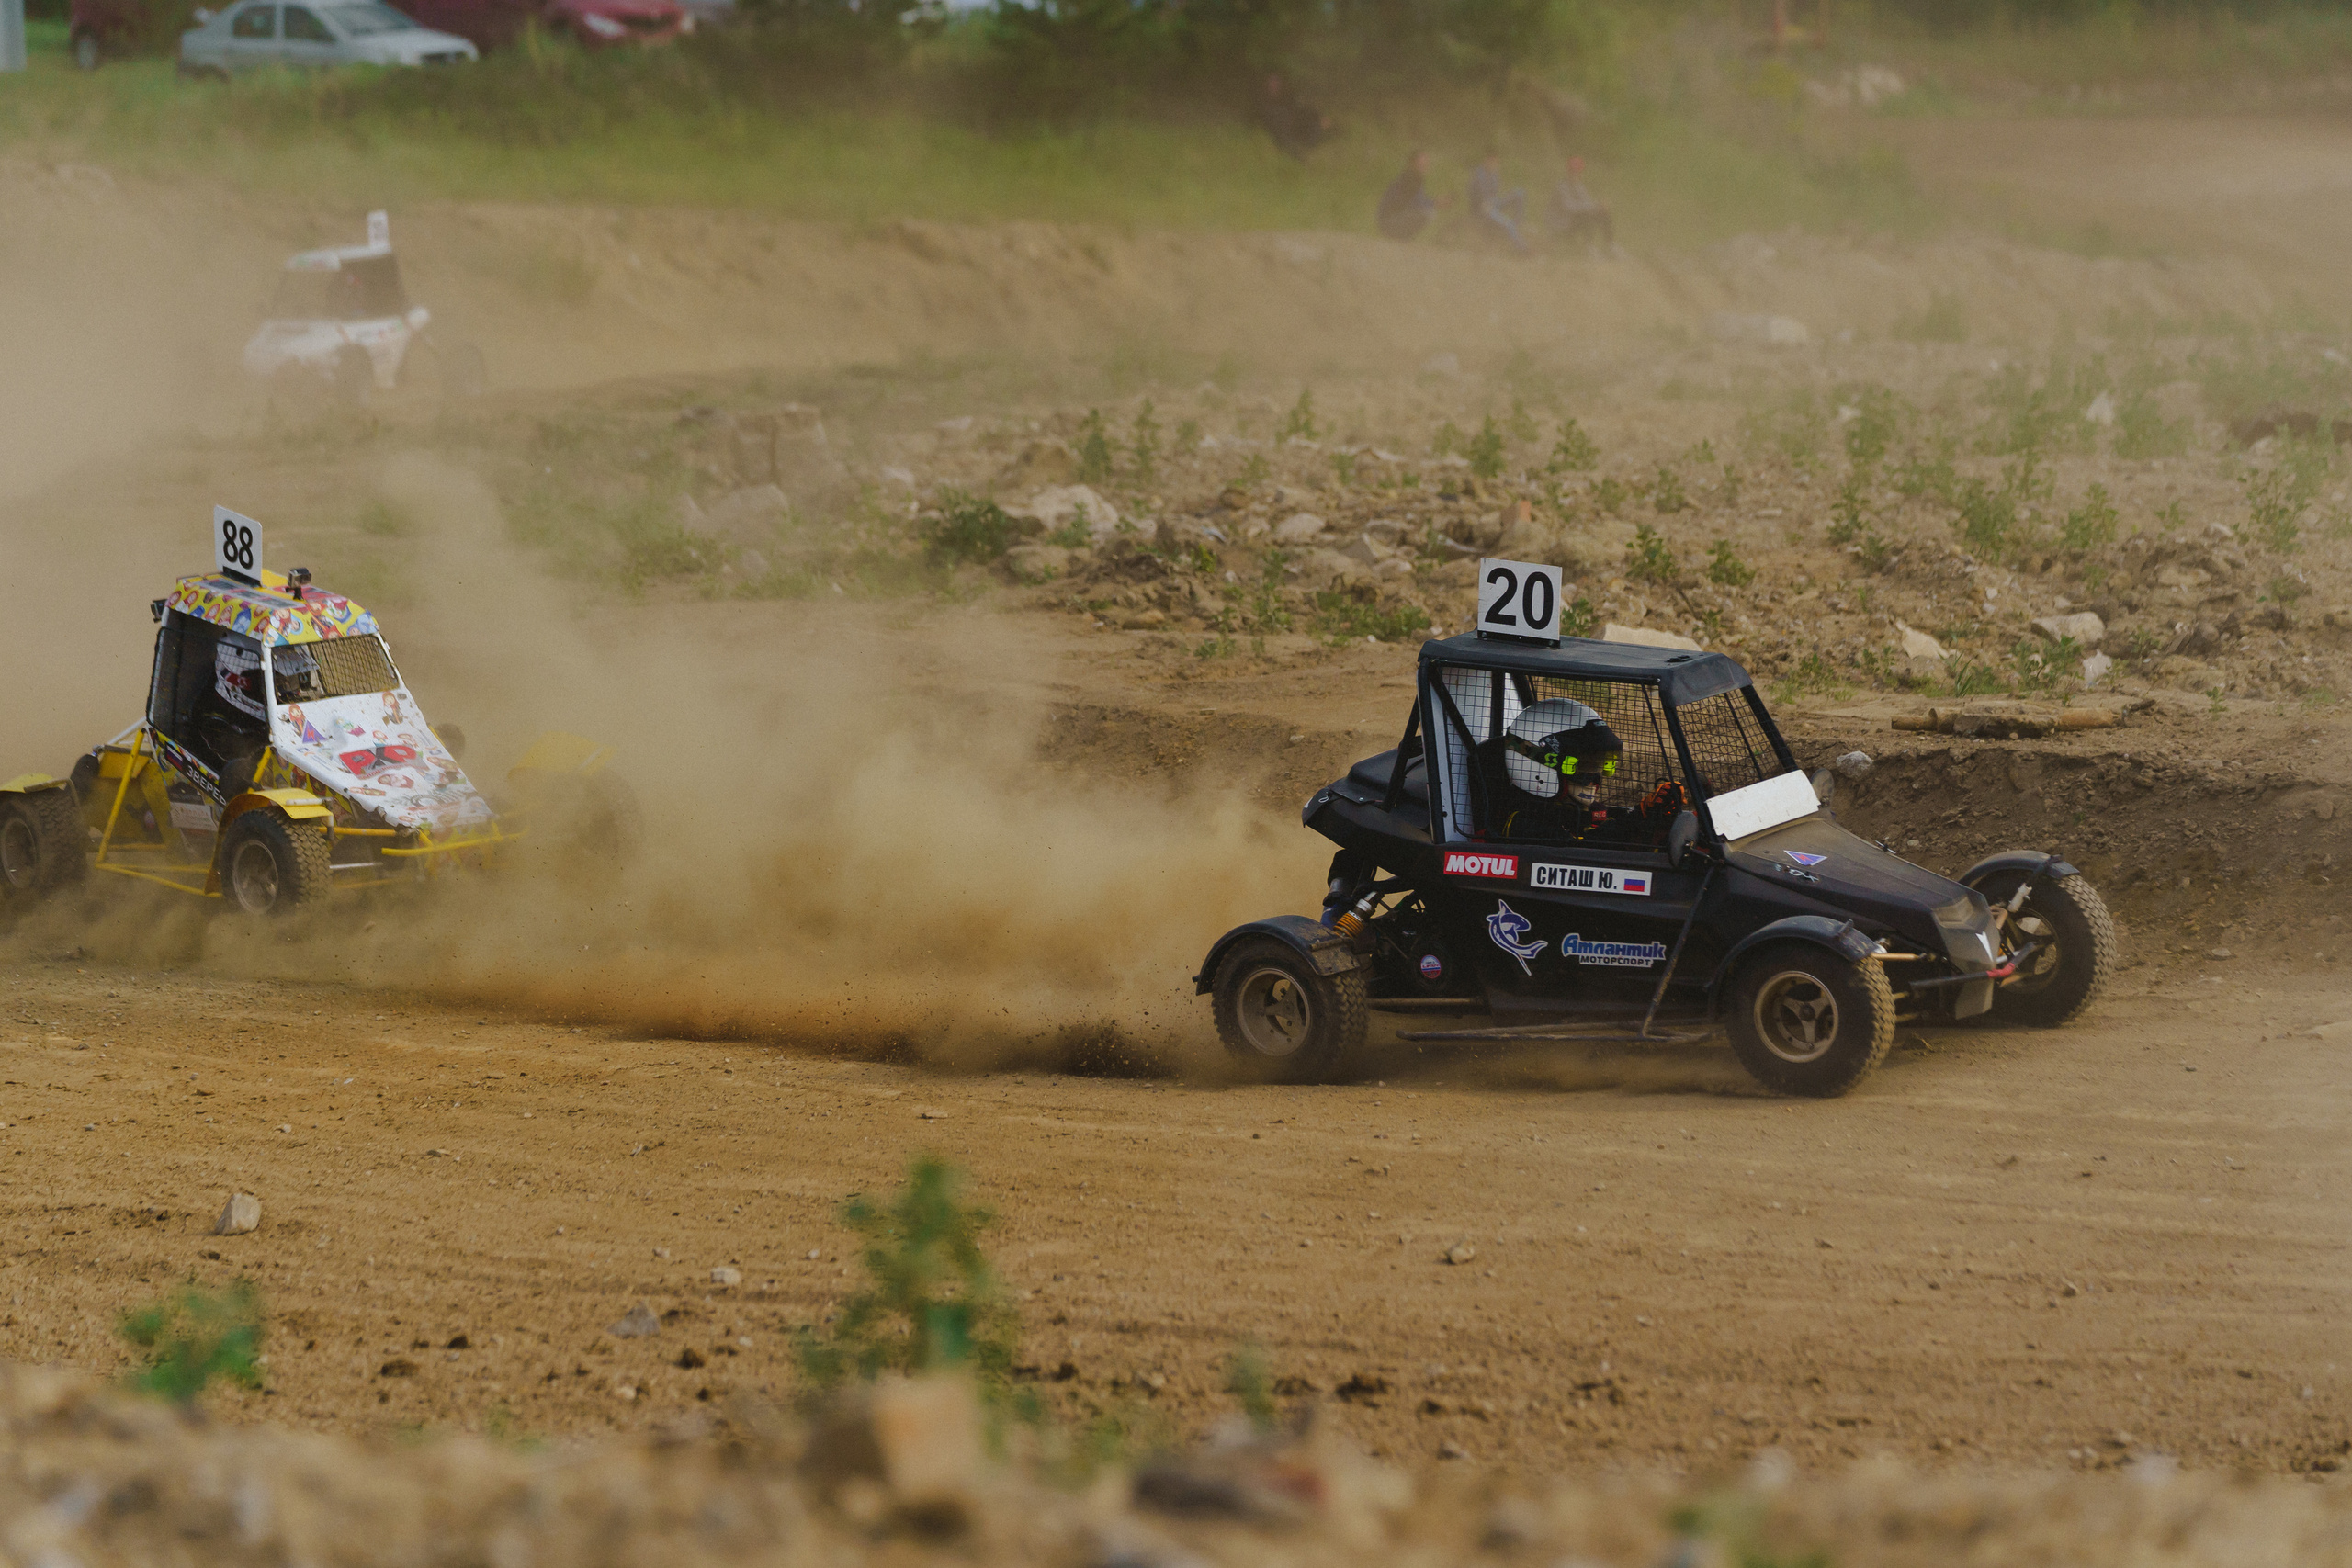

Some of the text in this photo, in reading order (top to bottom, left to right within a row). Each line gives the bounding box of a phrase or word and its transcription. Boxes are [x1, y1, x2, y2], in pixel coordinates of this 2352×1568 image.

[223, 519, 254, 570] 88
[1485, 567, 1554, 631] 20
[1445, 854, 1516, 877] MOTUL
[1536, 866, 1618, 890] СИТАШ Ю.
[1562, 933, 1666, 960] Атлантик
[1579, 955, 1652, 967] МОТОРСПОРТ
